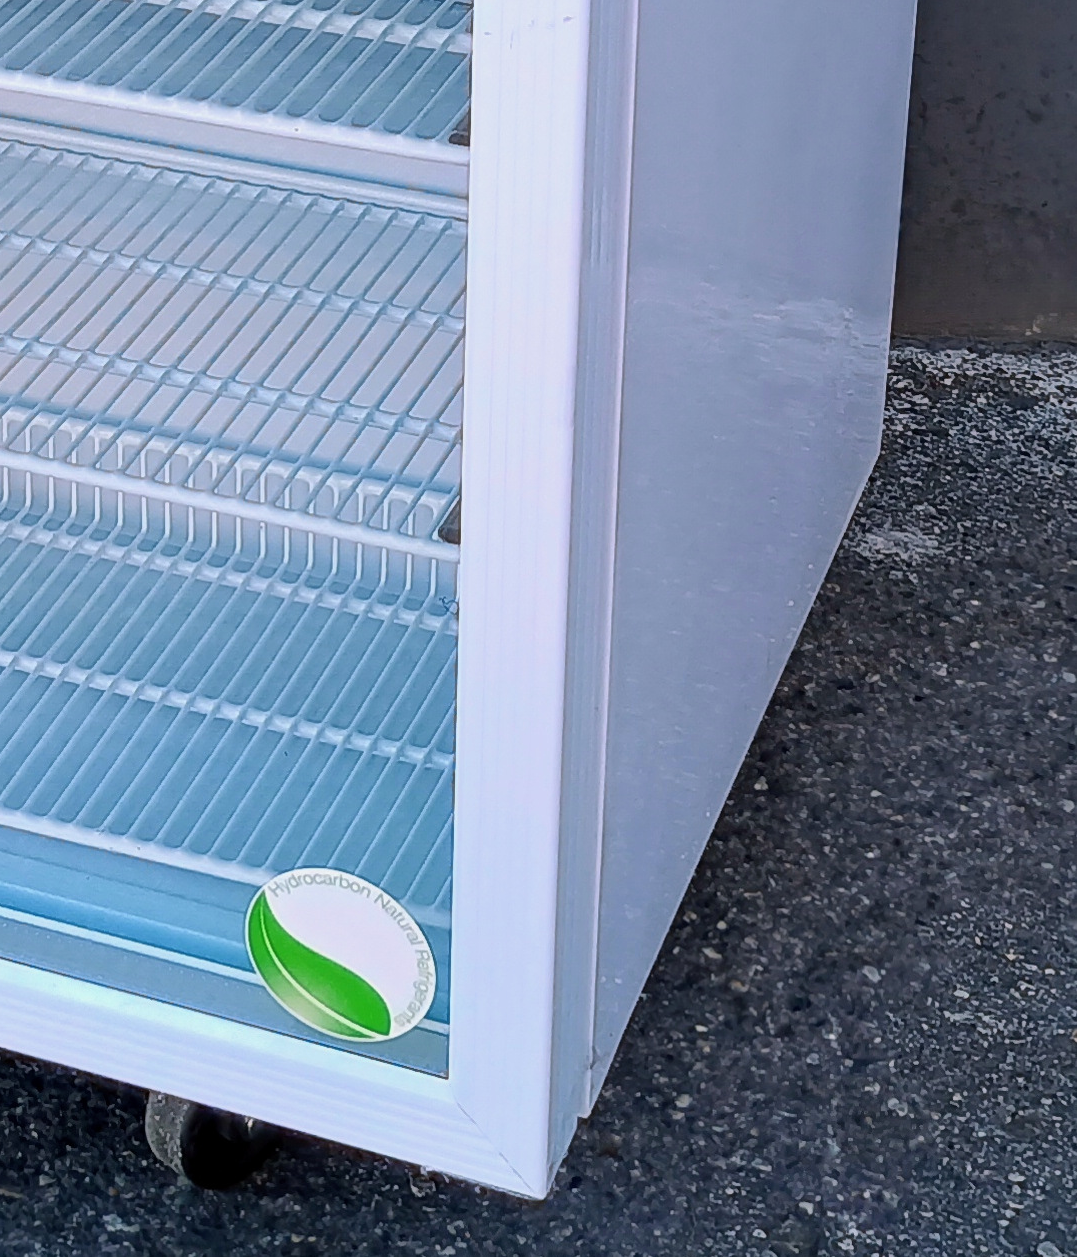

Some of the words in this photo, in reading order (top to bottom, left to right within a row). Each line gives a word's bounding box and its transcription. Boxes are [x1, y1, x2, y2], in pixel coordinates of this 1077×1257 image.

[268, 872, 372, 898] Hydrocarbon
[374, 893, 424, 946] Natural
[393, 949, 434, 1028] Refrigerants
